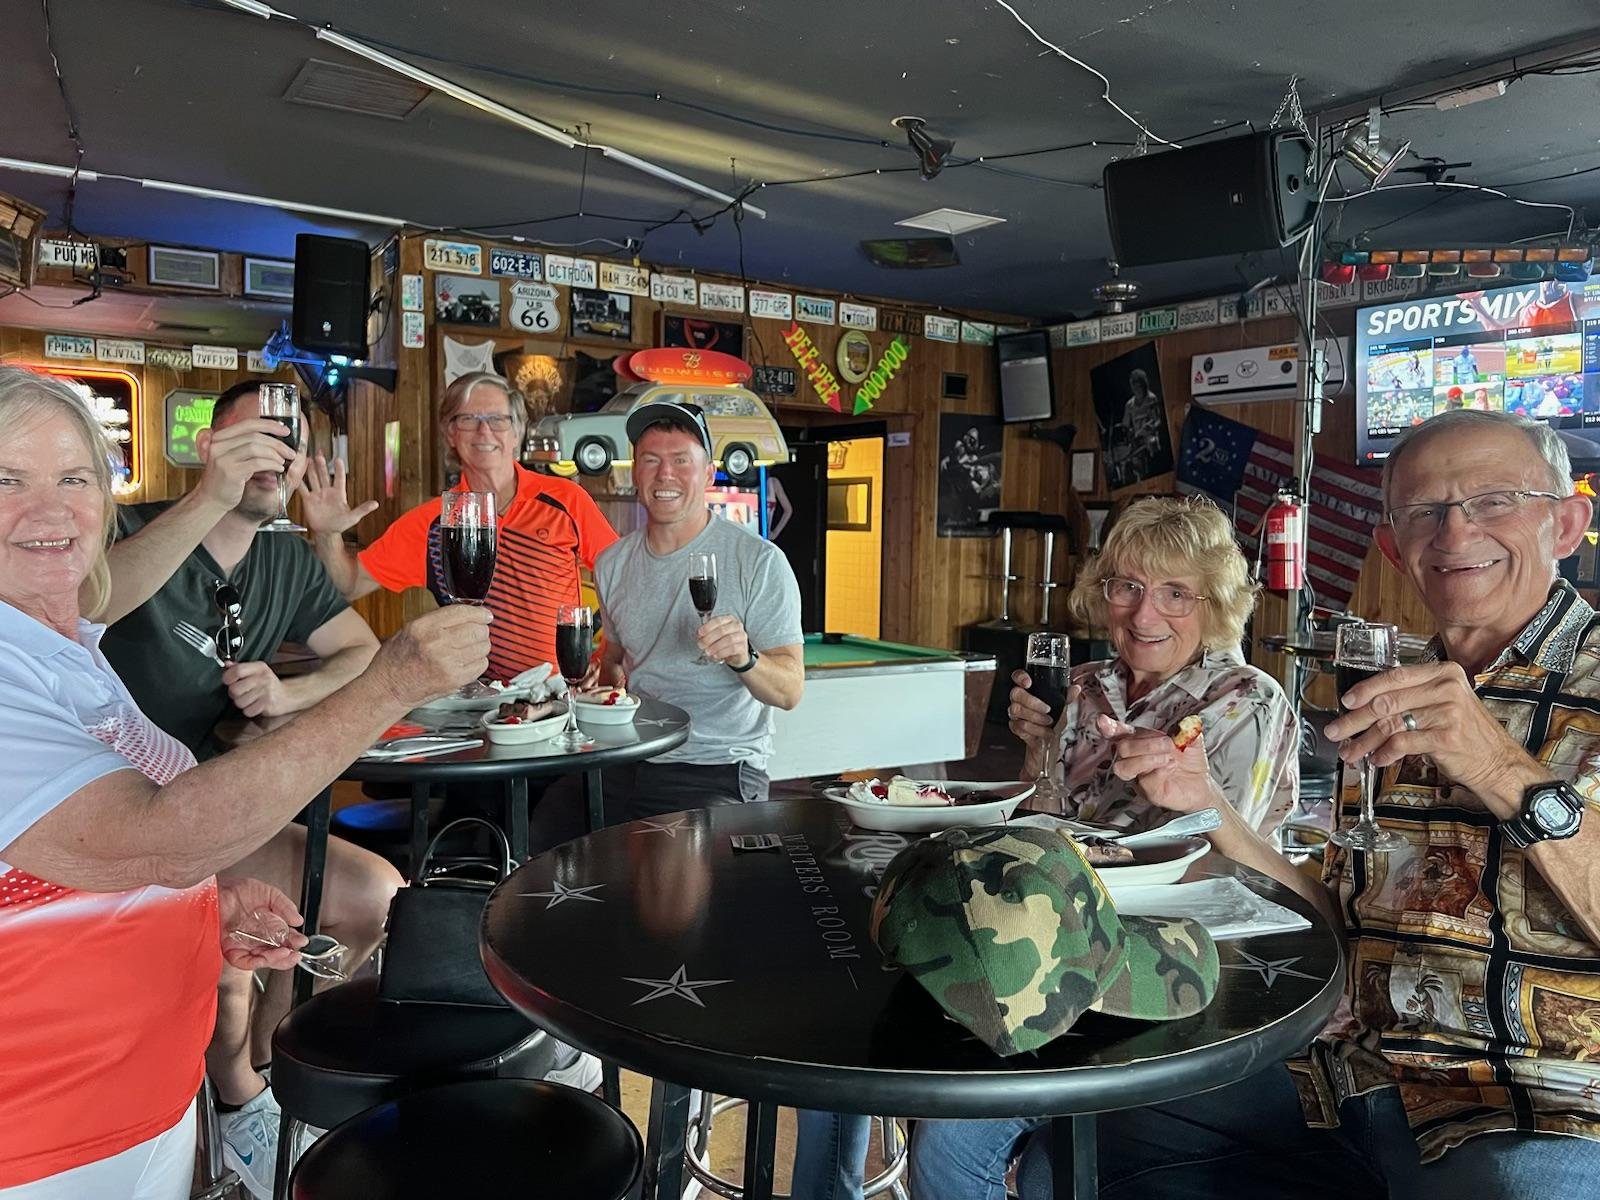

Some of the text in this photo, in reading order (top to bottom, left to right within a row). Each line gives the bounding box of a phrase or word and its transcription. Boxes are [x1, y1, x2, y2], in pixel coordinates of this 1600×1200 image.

[517, 286, 550, 297] ARIZONA
[520, 309, 549, 328] 66
[635, 366, 748, 380] BUDWEISER
[810, 905, 862, 960] ROOM
